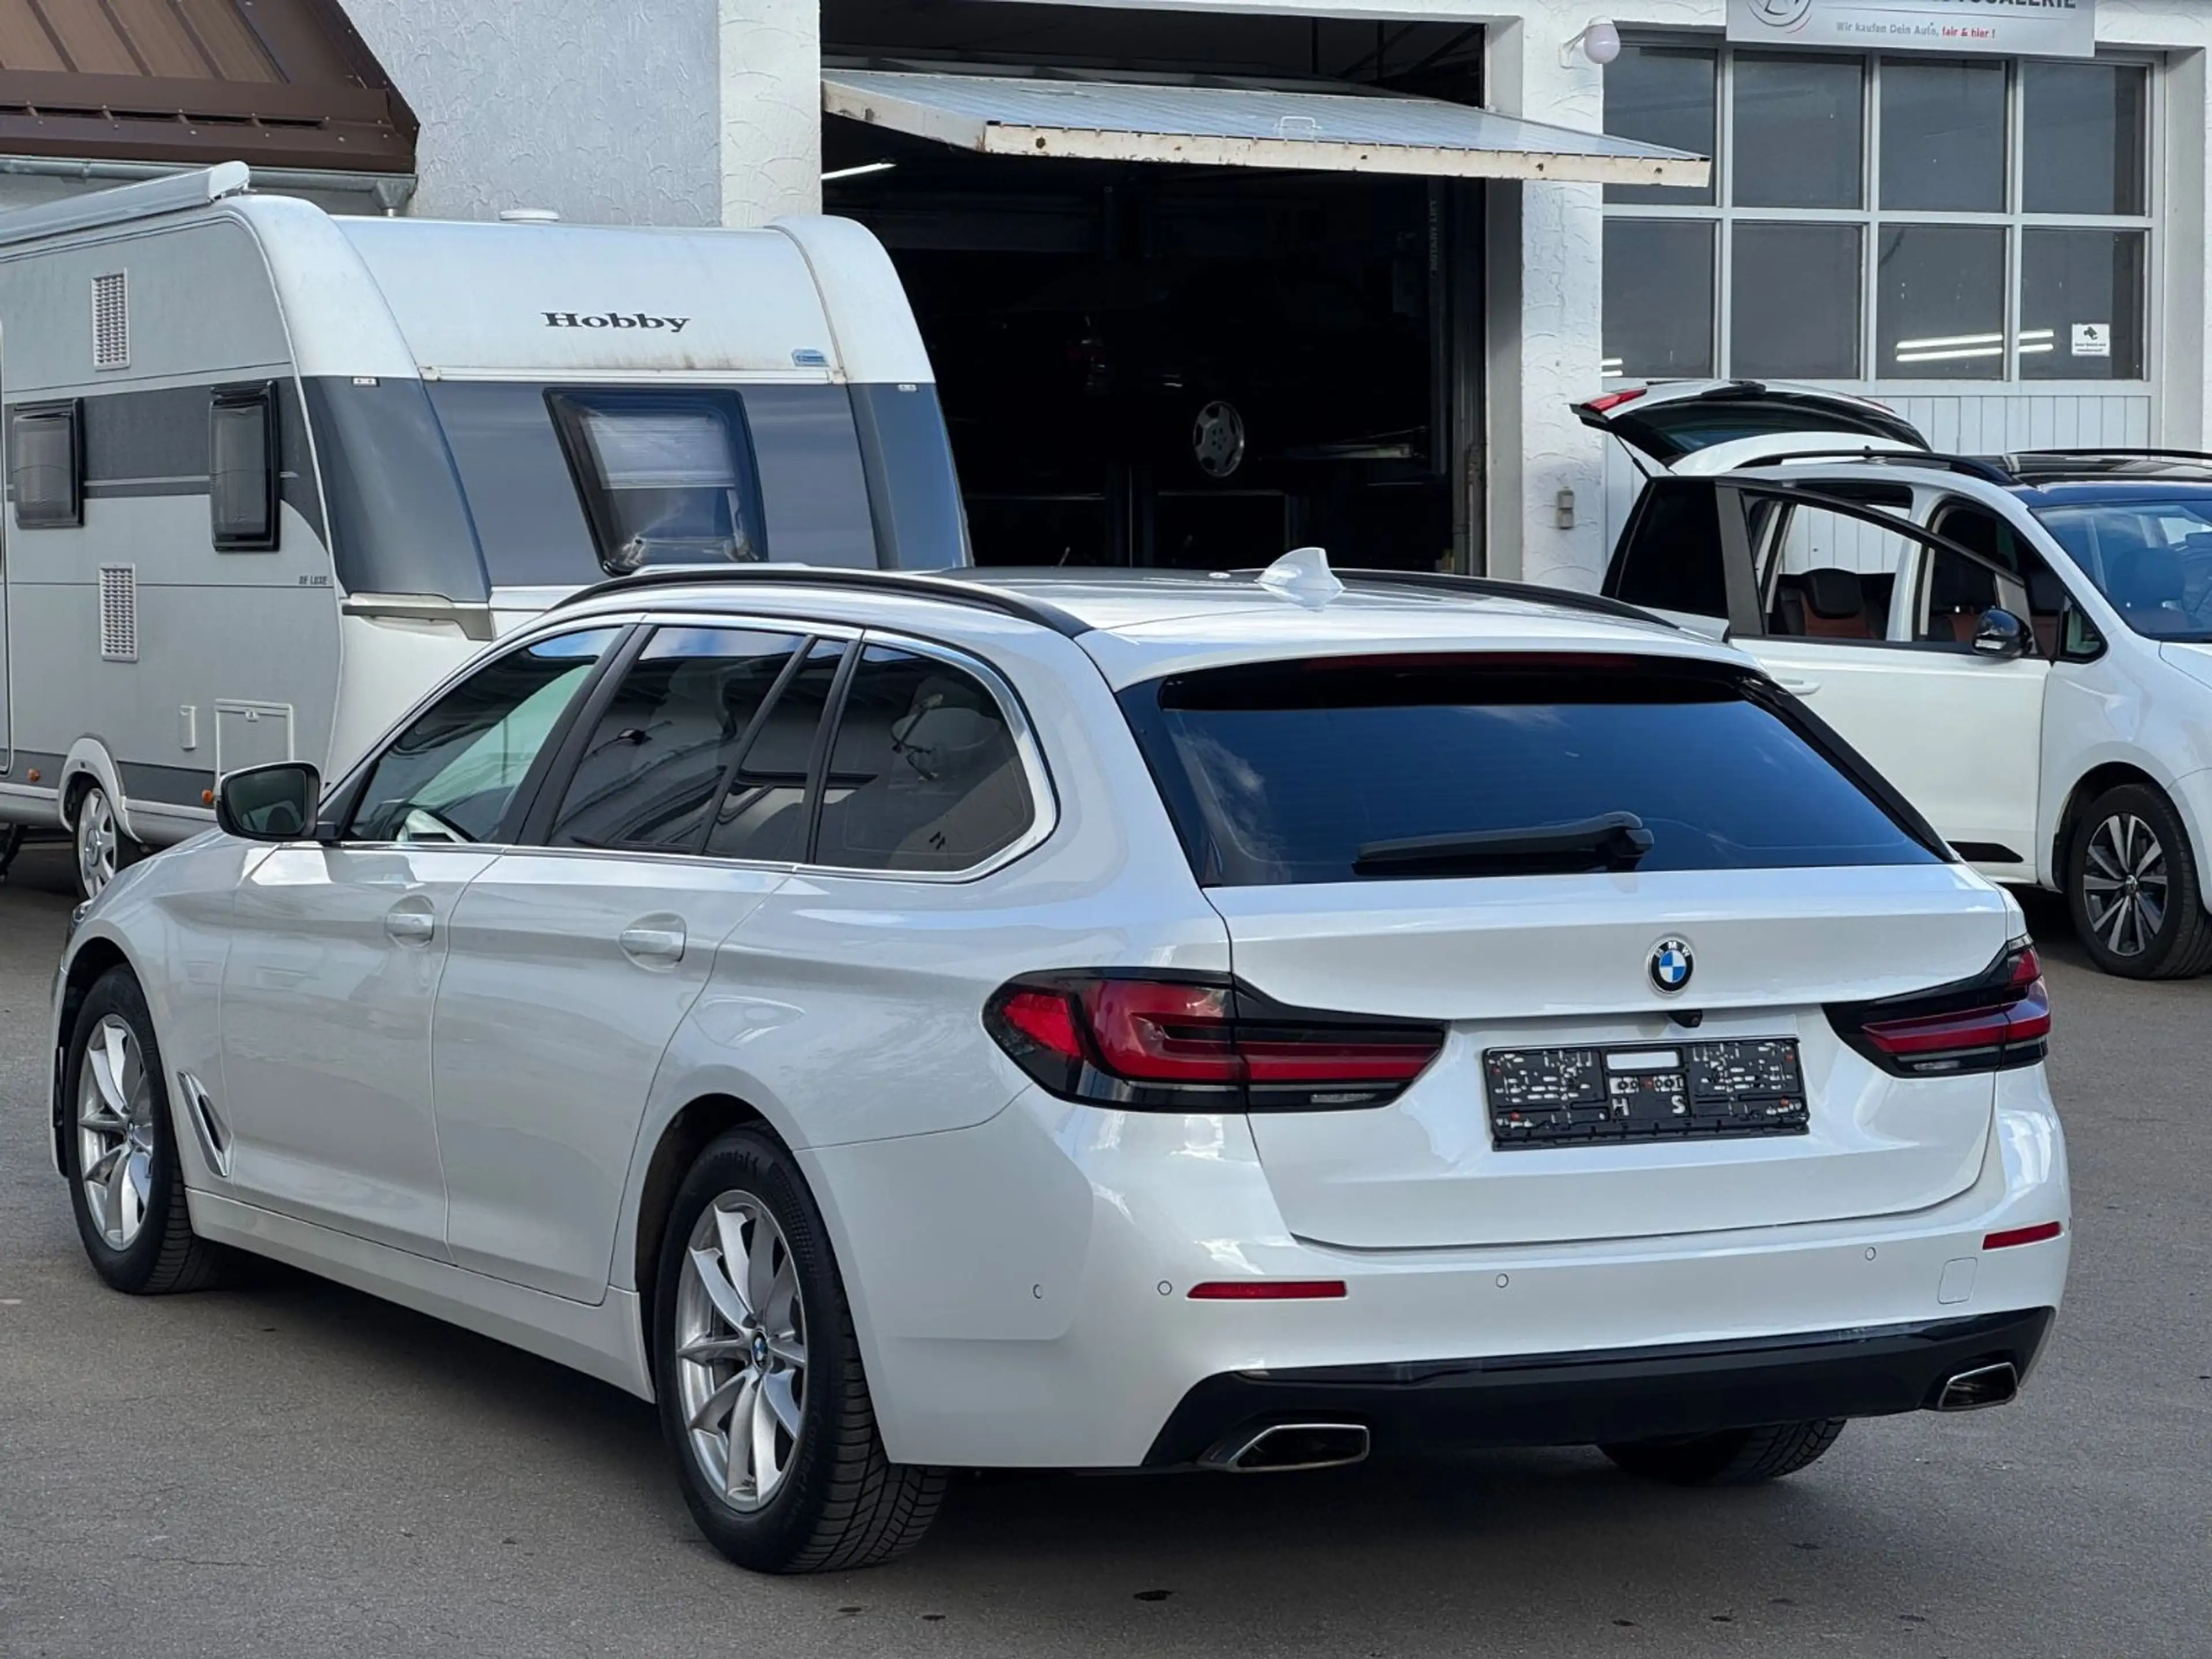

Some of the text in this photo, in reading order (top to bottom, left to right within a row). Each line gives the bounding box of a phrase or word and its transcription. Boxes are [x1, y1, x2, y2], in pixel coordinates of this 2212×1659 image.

[1836, 21, 1853, 32] Wir
[1855, 22, 1887, 33] kaufen
[1889, 24, 1911, 35] Dein
[1942, 26, 1958, 36] fair
[1961, 27, 1968, 36] &
[1971, 28, 1989, 38] hier
[542, 312, 691, 333] Hobby
[1654, 941, 1691, 958] BMW
